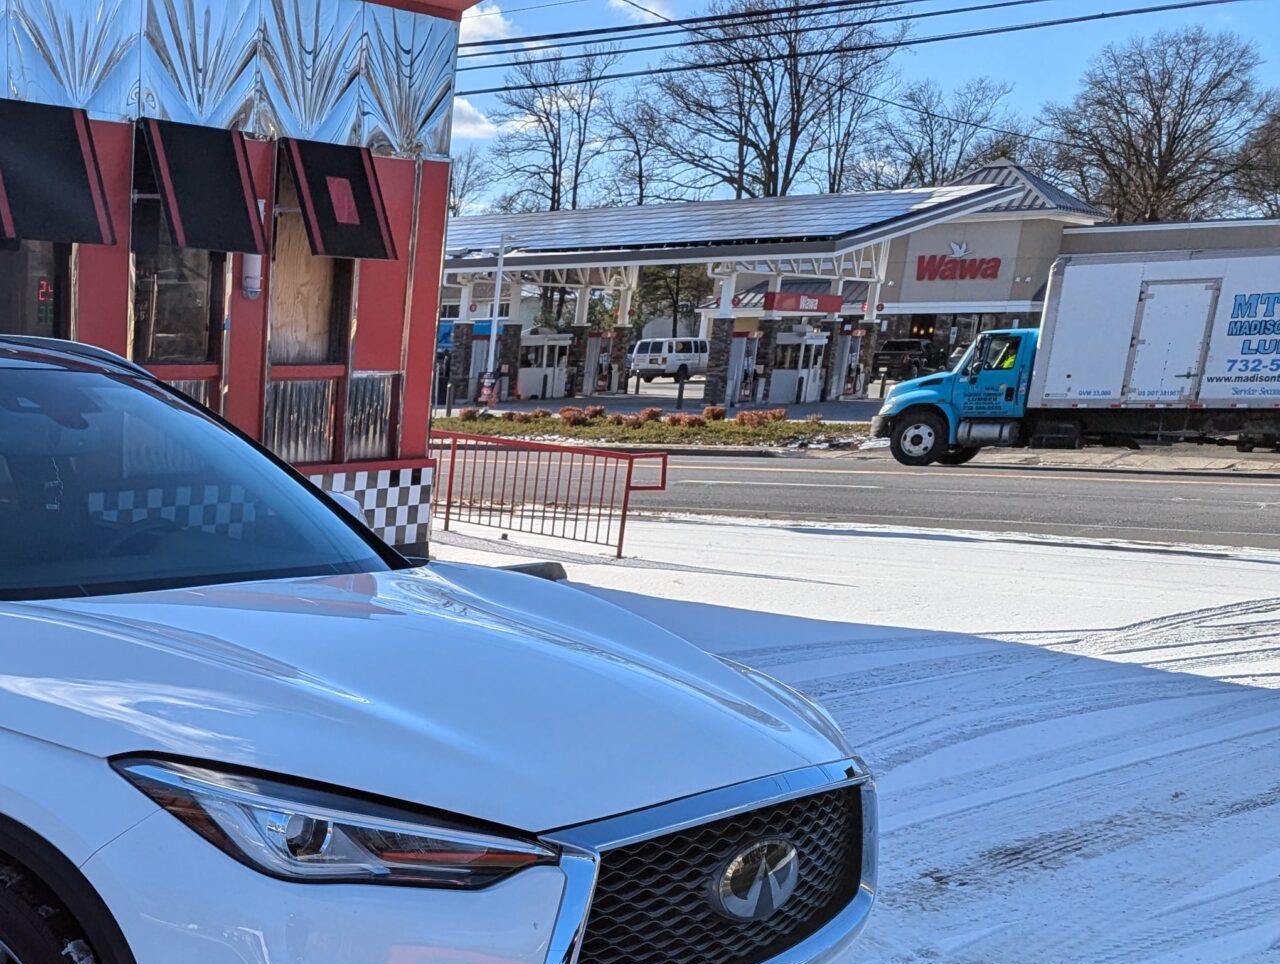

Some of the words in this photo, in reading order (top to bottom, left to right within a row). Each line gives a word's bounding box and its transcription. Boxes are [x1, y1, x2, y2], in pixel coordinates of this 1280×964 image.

[916, 254, 1001, 281] Wawa
[1241, 339, 1280, 355] LU
[1227, 359, 1280, 372] 732-5
[1231, 387, 1258, 396] Service
